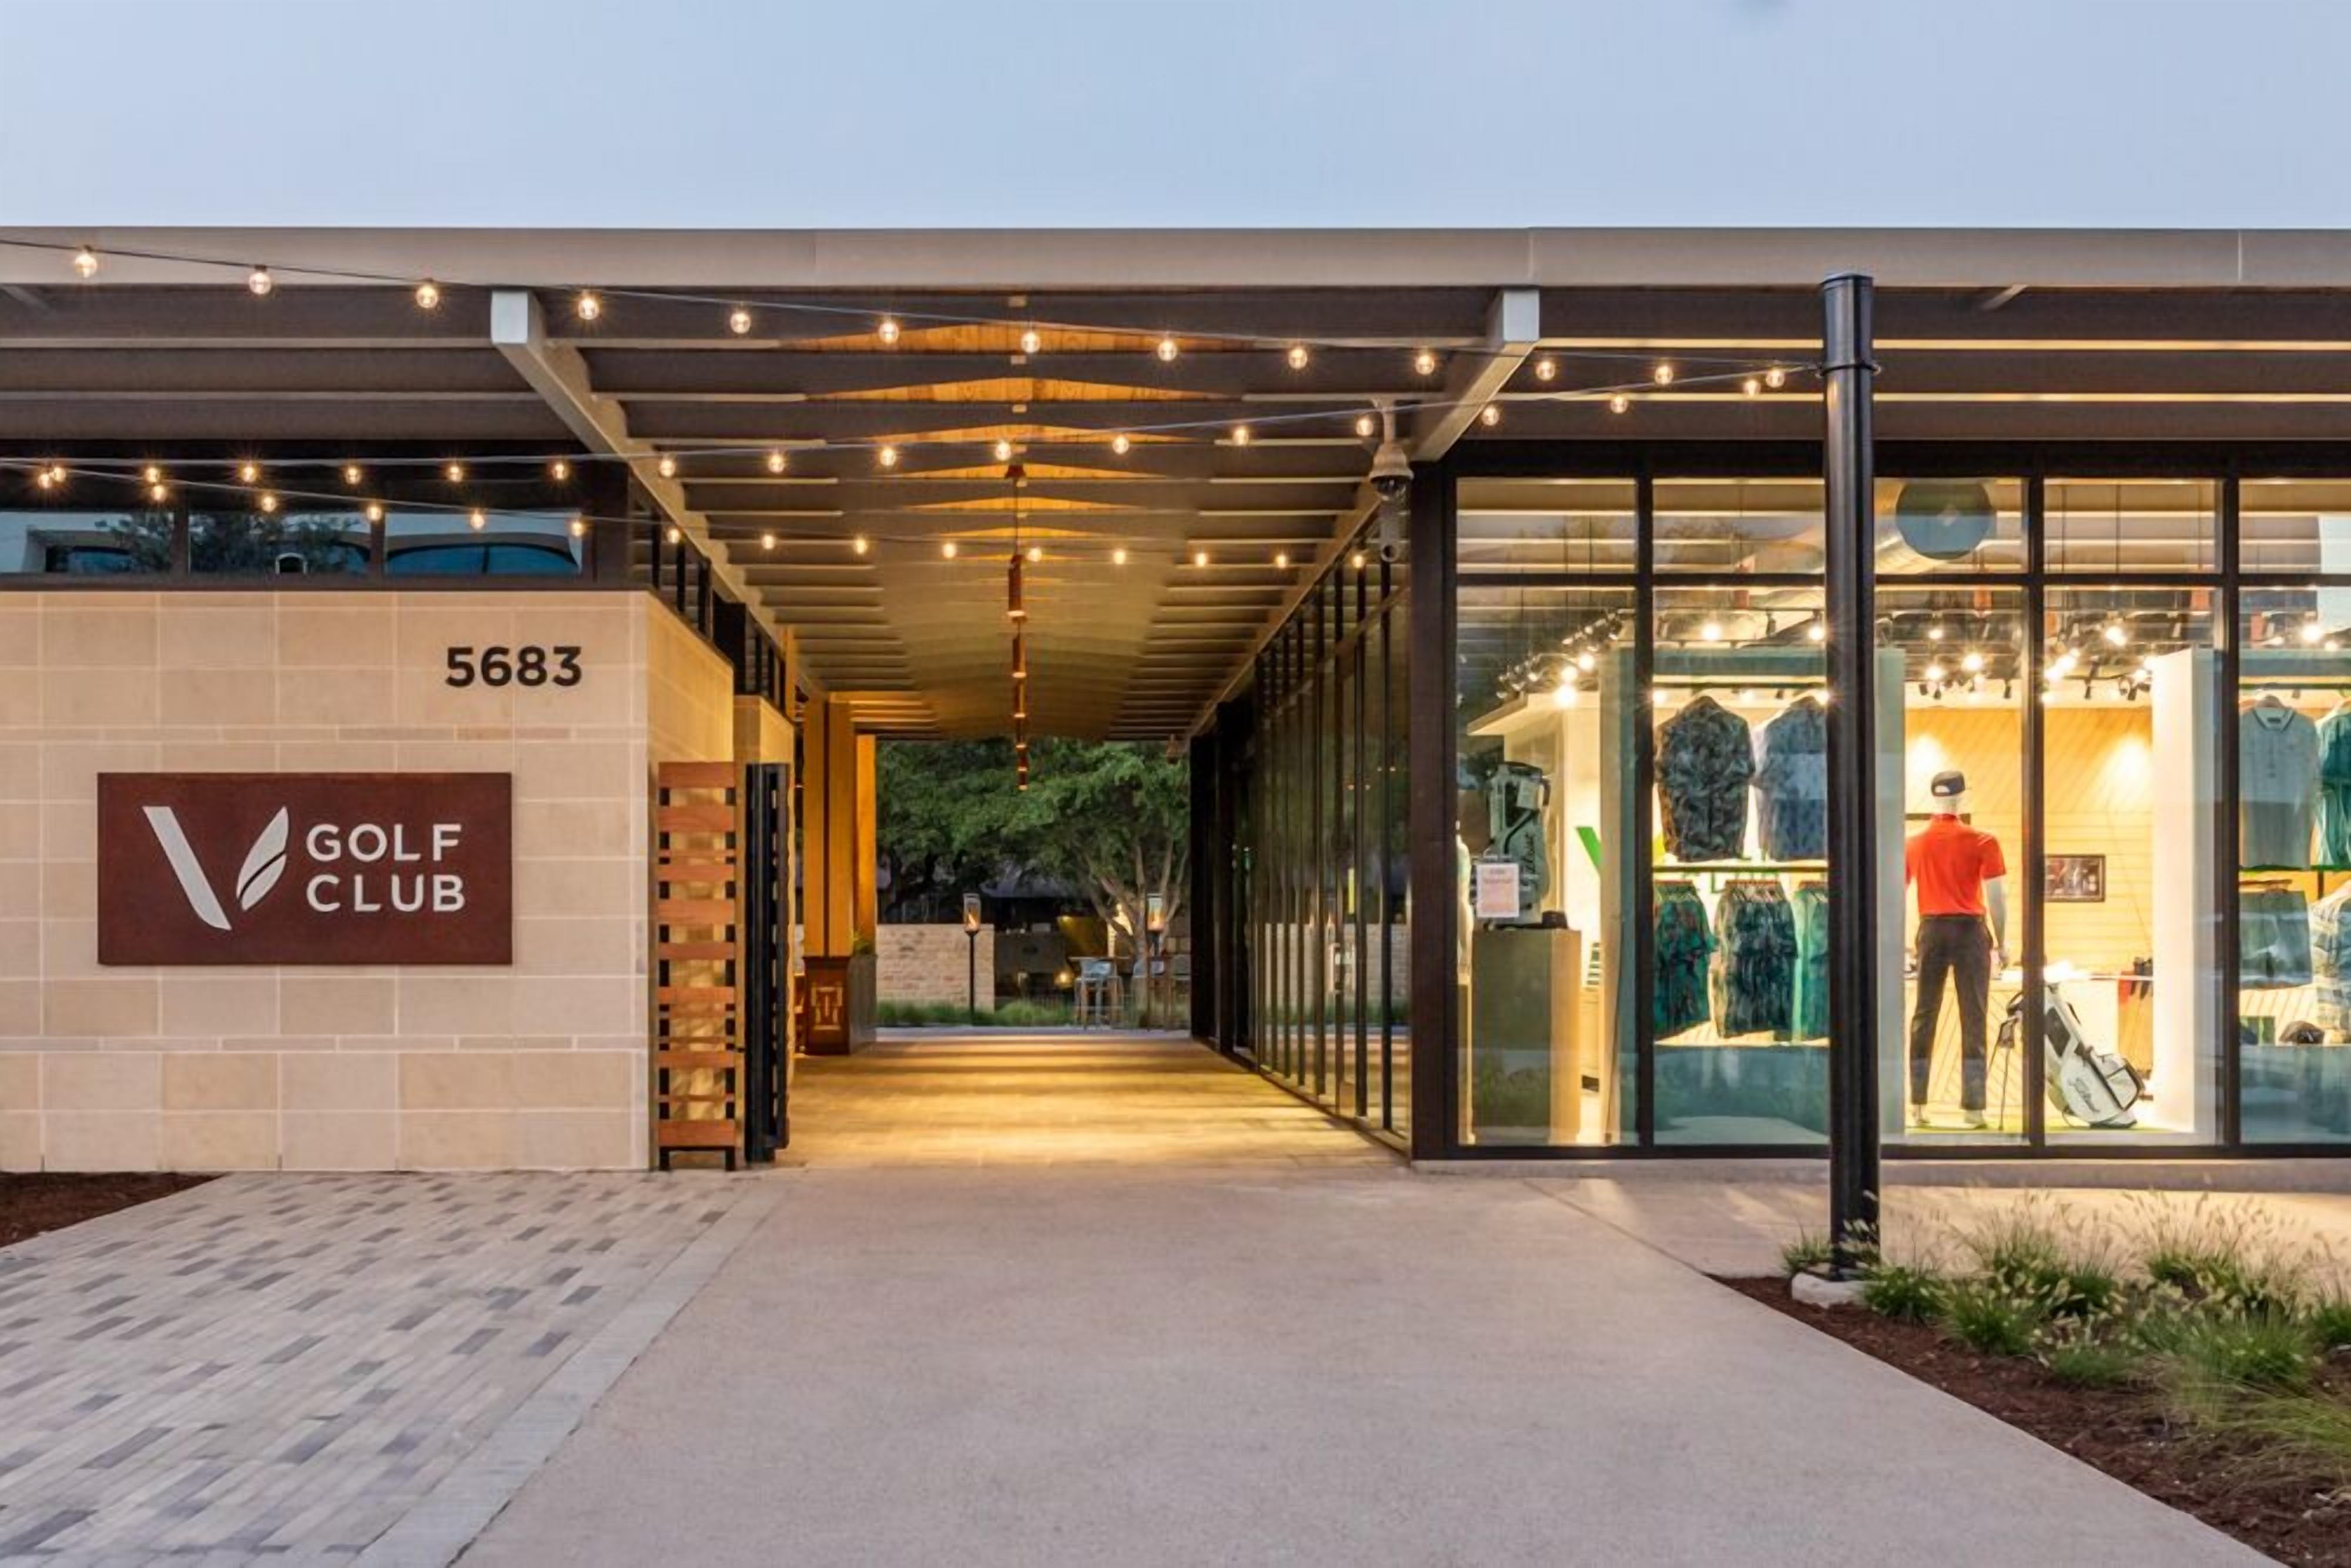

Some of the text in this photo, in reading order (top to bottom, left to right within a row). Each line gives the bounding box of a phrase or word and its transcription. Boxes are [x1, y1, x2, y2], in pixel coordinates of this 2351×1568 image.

[445, 645, 582, 688] 5683
[306, 823, 461, 862] GOLF
[306, 874, 465, 912] CLUB
